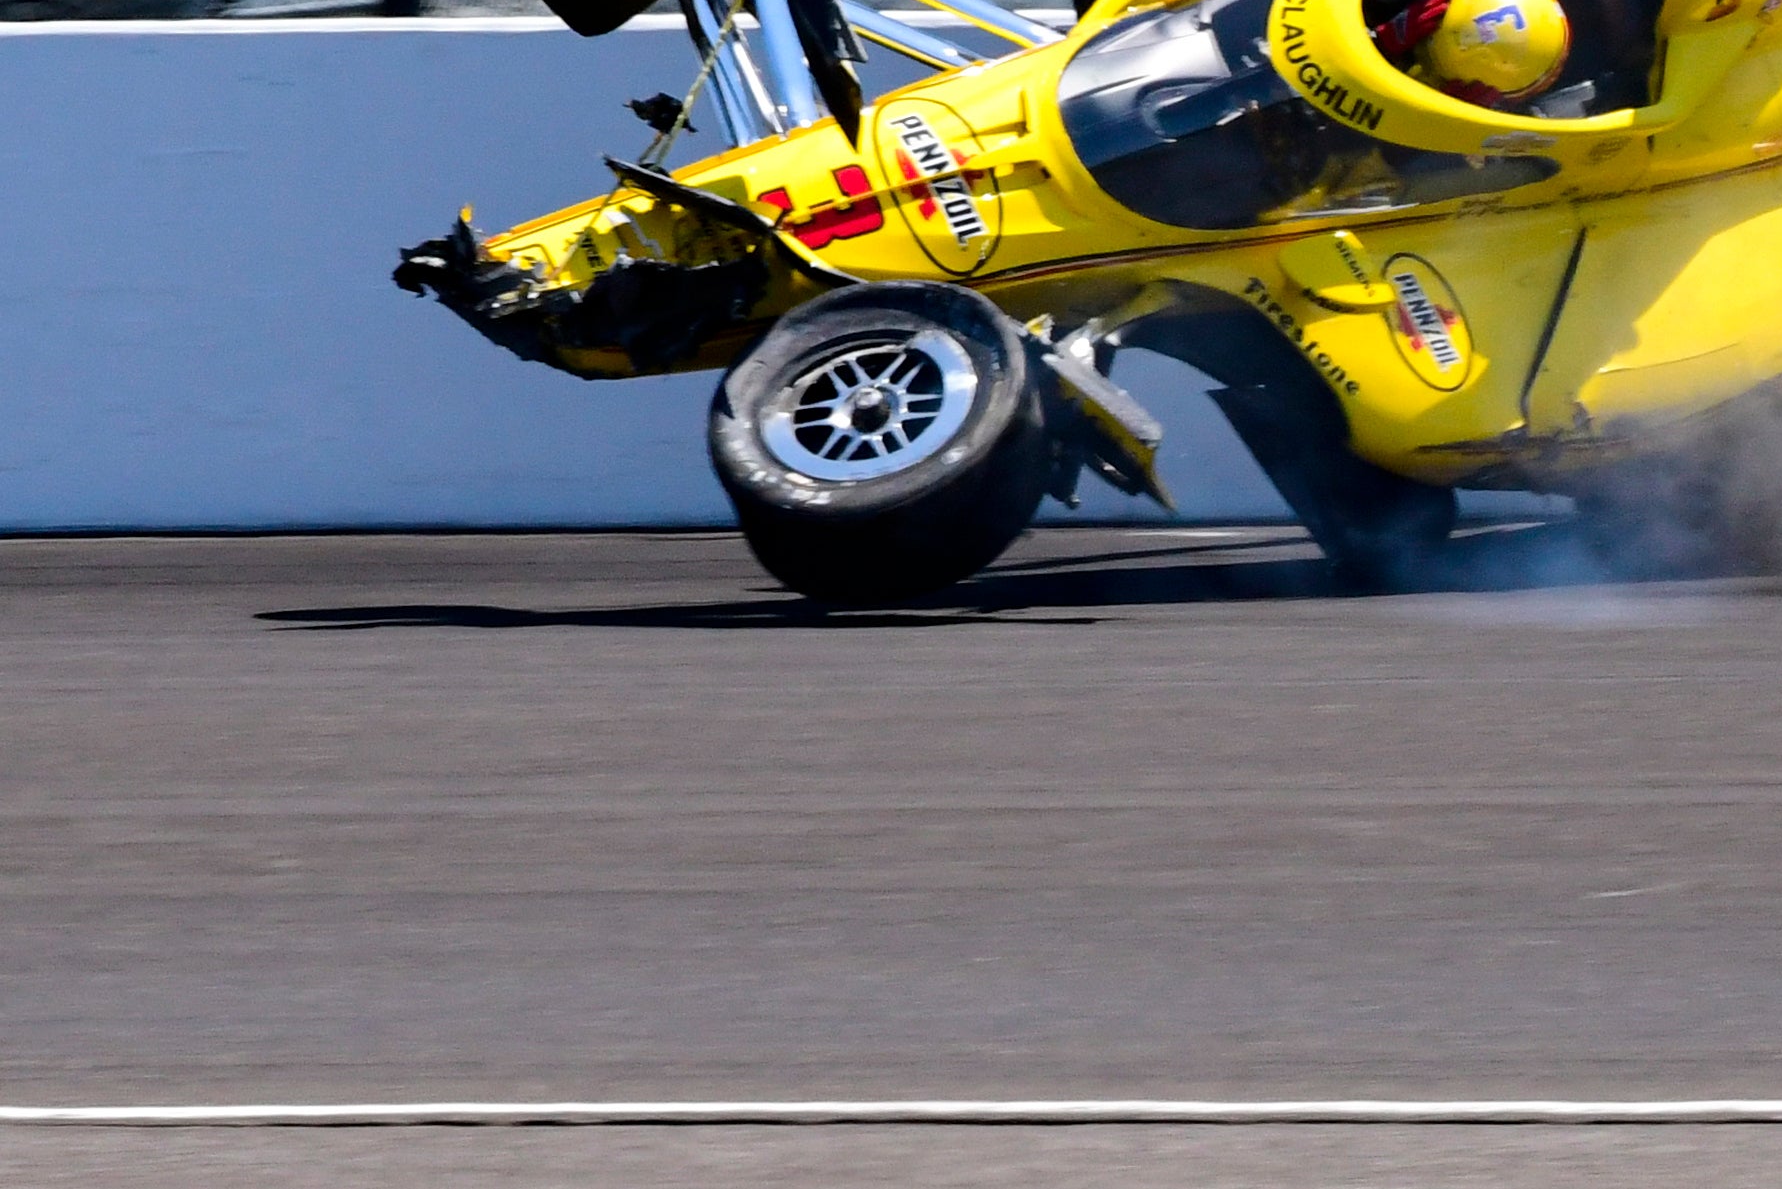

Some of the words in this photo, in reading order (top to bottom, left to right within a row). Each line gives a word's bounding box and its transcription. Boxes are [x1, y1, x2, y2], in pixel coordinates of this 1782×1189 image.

[890, 114, 985, 247] PENNZOIL
[1244, 276, 1360, 396] Firestone
[1393, 272, 1459, 365] PENNZOIL
